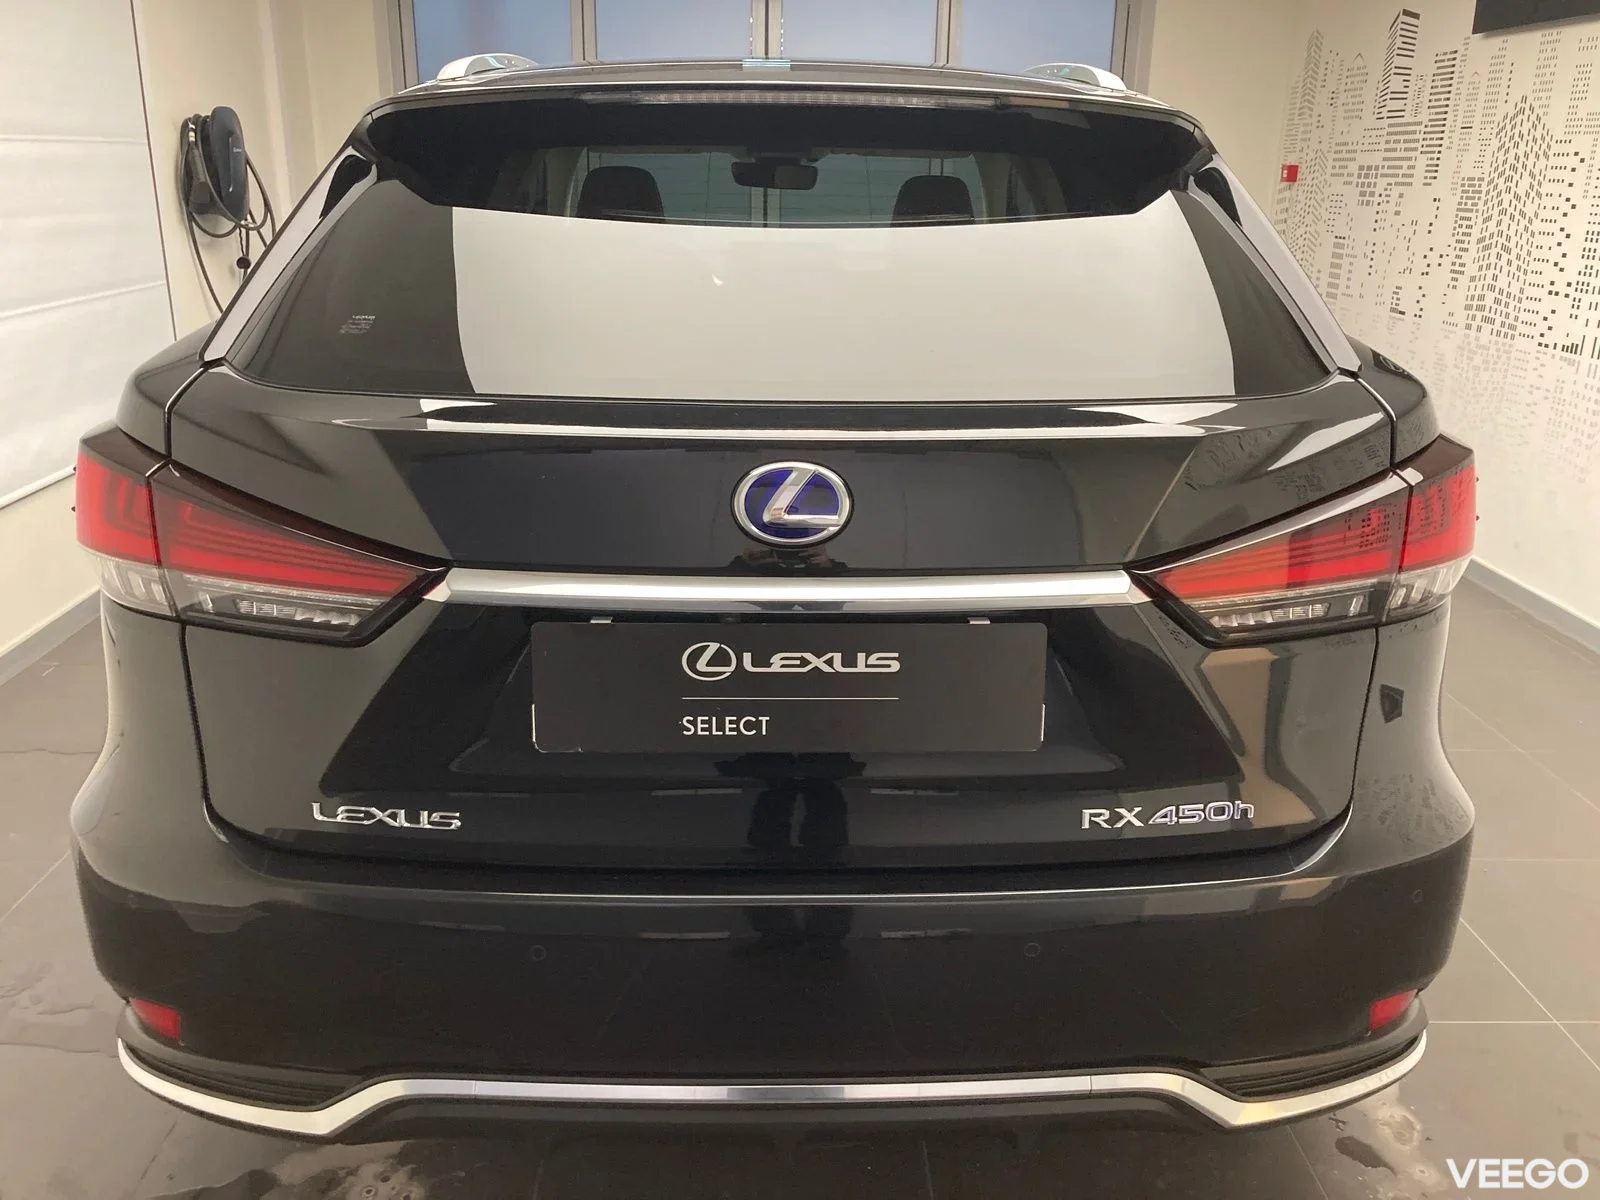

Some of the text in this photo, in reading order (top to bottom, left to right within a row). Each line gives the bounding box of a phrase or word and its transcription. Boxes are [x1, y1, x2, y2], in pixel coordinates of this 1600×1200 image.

[742, 652, 901, 673] LEXUS
[682, 715, 770, 736] SELECT
[312, 802, 462, 830] LEXUS
[1081, 800, 1255, 829] RX 450h
